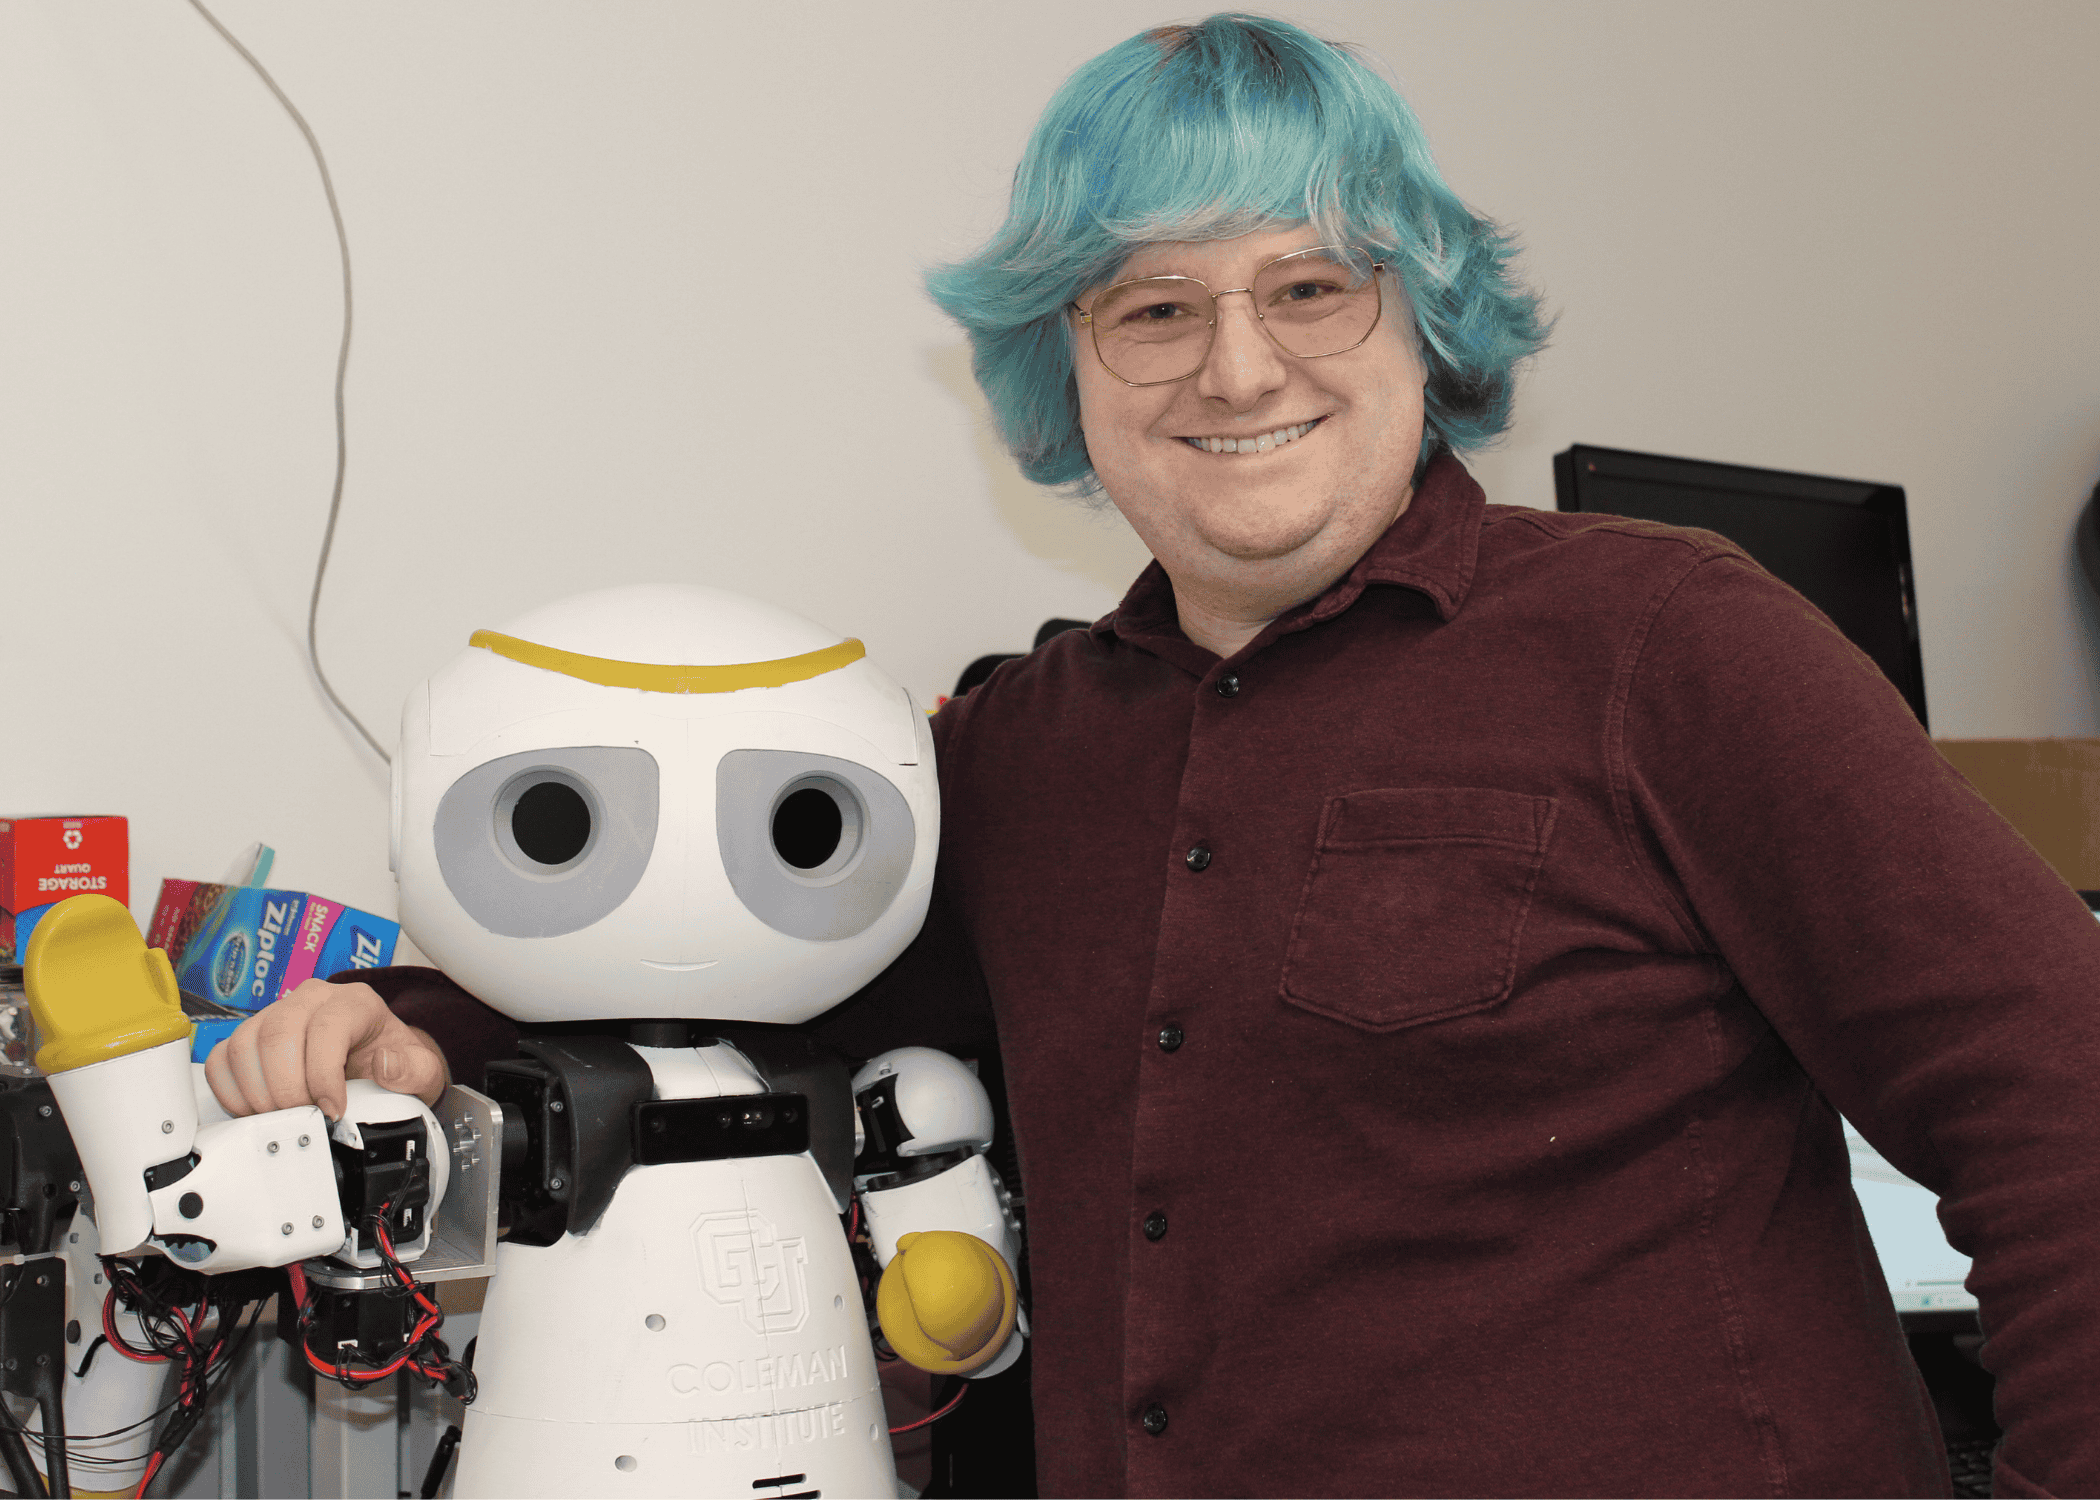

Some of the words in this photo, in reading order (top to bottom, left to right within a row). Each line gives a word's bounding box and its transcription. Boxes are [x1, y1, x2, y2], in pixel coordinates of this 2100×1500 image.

[38, 876, 107, 891] STORAGE
[54, 863, 91, 874] QUART
[252, 900, 288, 998] Ziploc
[303, 904, 329, 954] SNACK
[350, 932, 382, 969] Zip
[666, 1345, 848, 1394] COLEMAN
[688, 1401, 845, 1454] INSTITUTE
